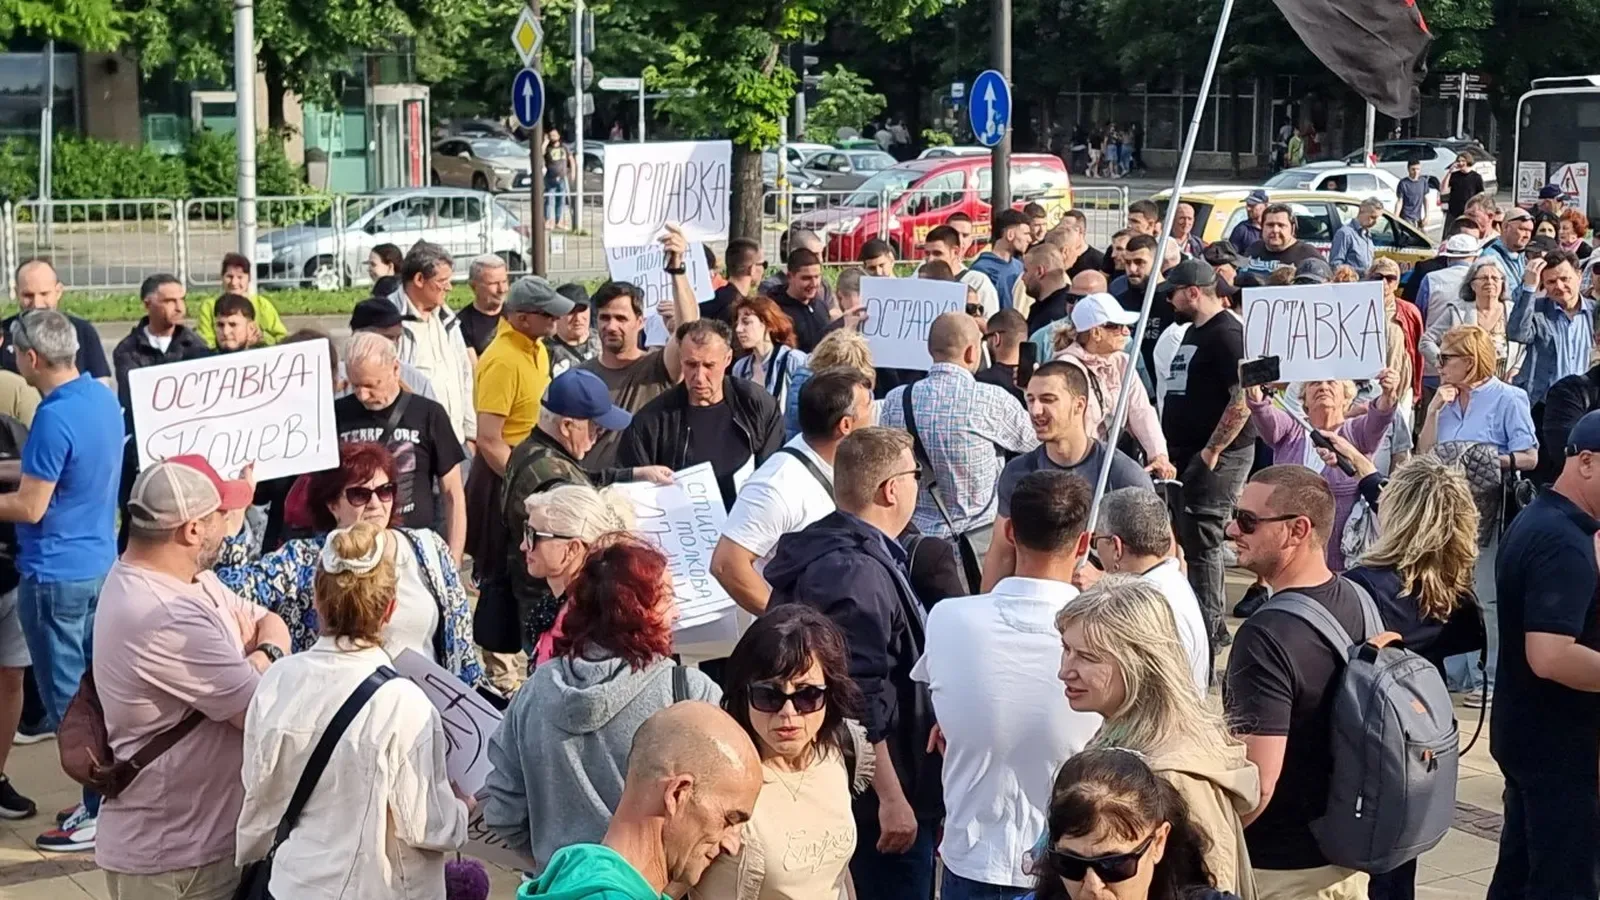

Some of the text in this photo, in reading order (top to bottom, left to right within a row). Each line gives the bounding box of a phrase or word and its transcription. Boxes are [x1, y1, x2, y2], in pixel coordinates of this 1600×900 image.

[607, 160, 725, 231] ОСТАВКА
[861, 298, 958, 342] ОСТАВ
[1245, 298, 1383, 363] ОСТАВКА
[151, 353, 313, 414] ОСТАВКА
[675, 520, 713, 599] ТОЛКОВА
